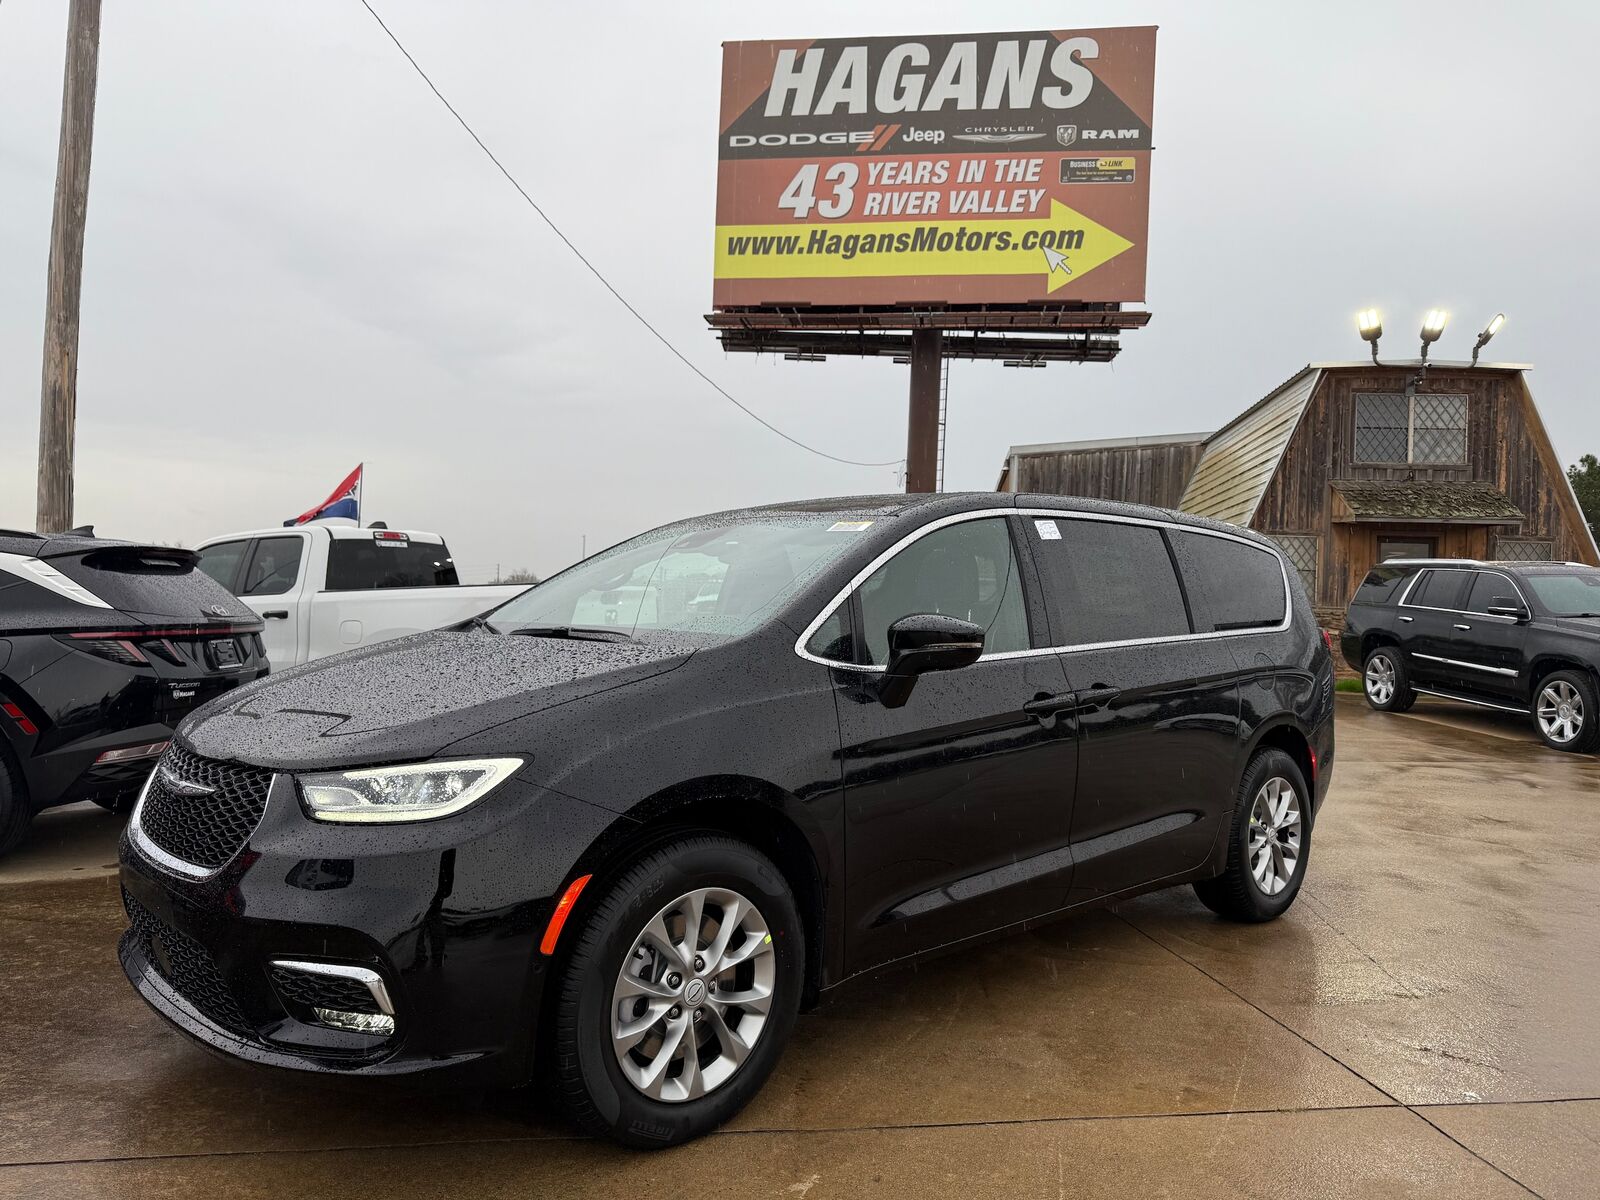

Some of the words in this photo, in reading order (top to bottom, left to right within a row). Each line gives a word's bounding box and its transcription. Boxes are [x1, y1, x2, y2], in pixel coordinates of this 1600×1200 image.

[764, 37, 1099, 117] HAGANS
[729, 131, 876, 147] DODGE
[902, 126, 945, 145] Jeep
[964, 125, 1035, 133] CHRYSLER
[1081, 128, 1140, 140] RAM
[866, 160, 951, 186] YEARS
[956, 159, 987, 184] IN
[993, 158, 1045, 183] THE
[777, 161, 860, 219] 43
[863, 190, 942, 216] RIVER
[949, 188, 1047, 214] VALLEY
[727, 226, 1086, 260] www.HagansMotors.com
